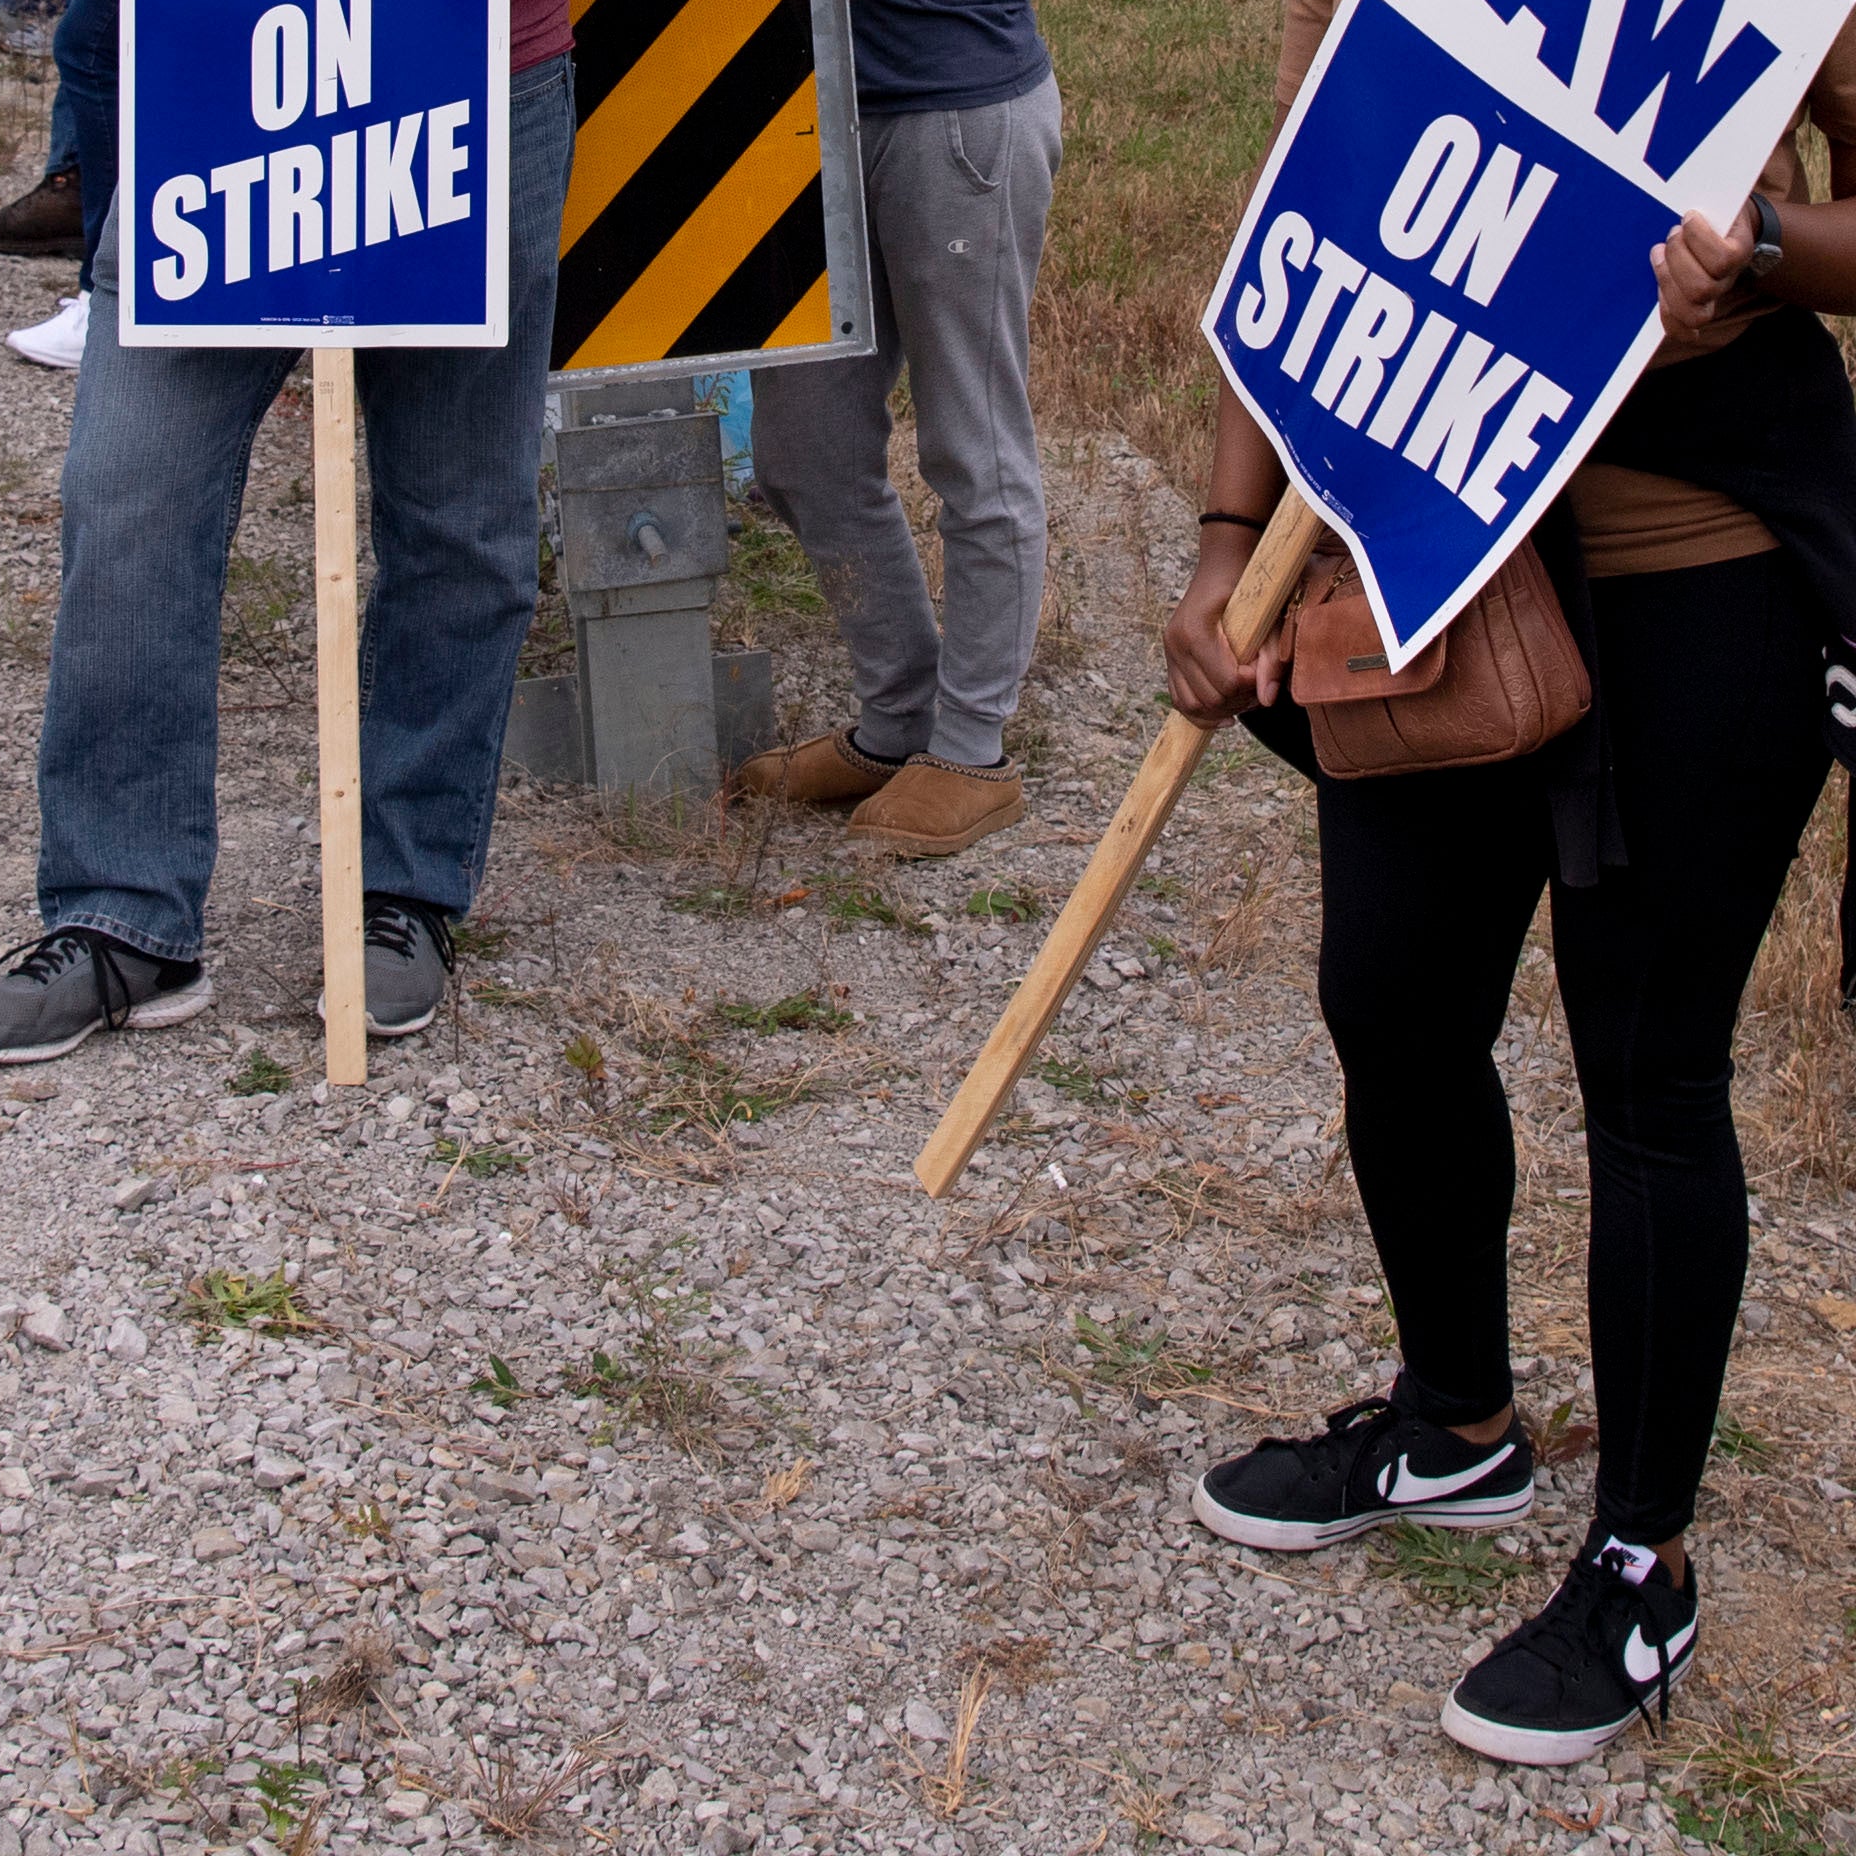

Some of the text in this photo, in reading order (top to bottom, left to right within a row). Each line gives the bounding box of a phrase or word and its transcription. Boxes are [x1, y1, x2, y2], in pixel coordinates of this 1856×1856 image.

[150, 98, 472, 303] STRIKE
[1378, 113, 1559, 309] ON
[1234, 209, 1575, 526] STRIKE
